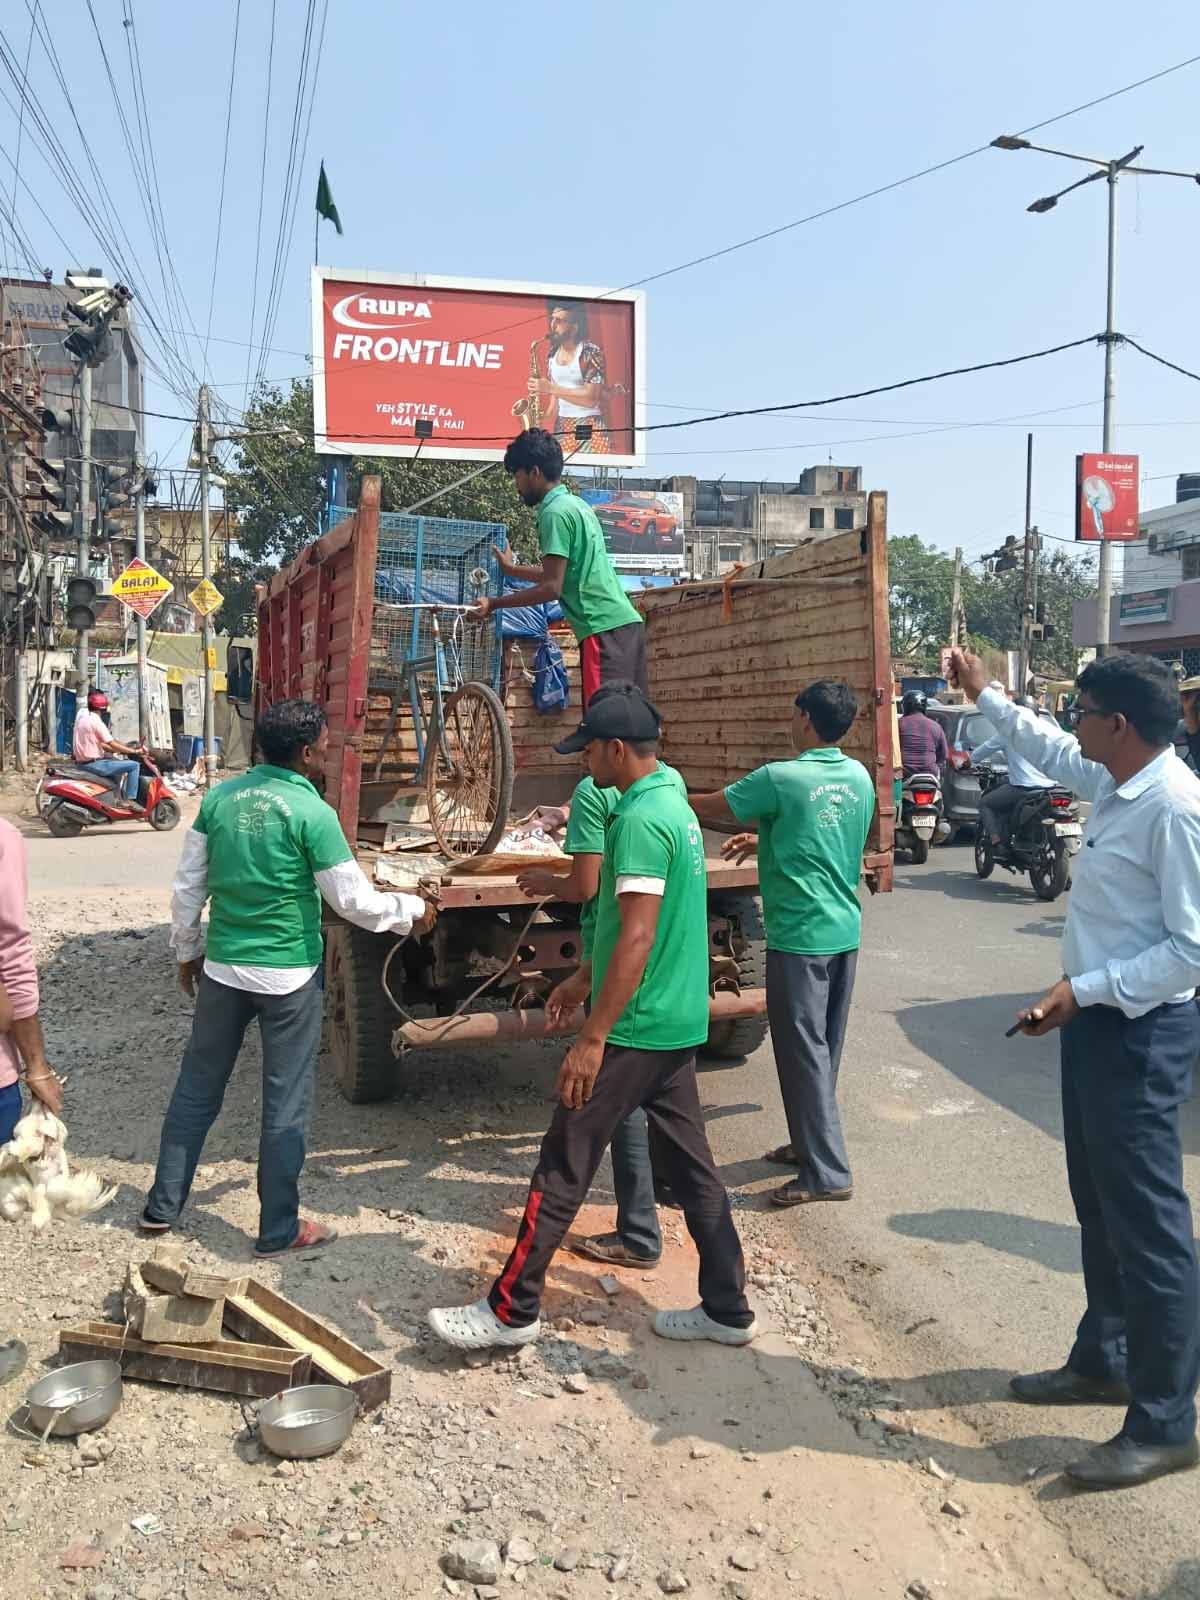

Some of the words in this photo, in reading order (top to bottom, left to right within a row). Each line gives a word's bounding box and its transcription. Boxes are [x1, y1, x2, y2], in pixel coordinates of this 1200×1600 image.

[359, 297, 432, 318] RUPA
[332, 332, 504, 369] FRONTLINE
[376, 403, 395, 413] YEH
[397, 402, 437, 416] STYLE
[439, 407, 453, 417] KA
[121, 576, 159, 589] BALAJI
